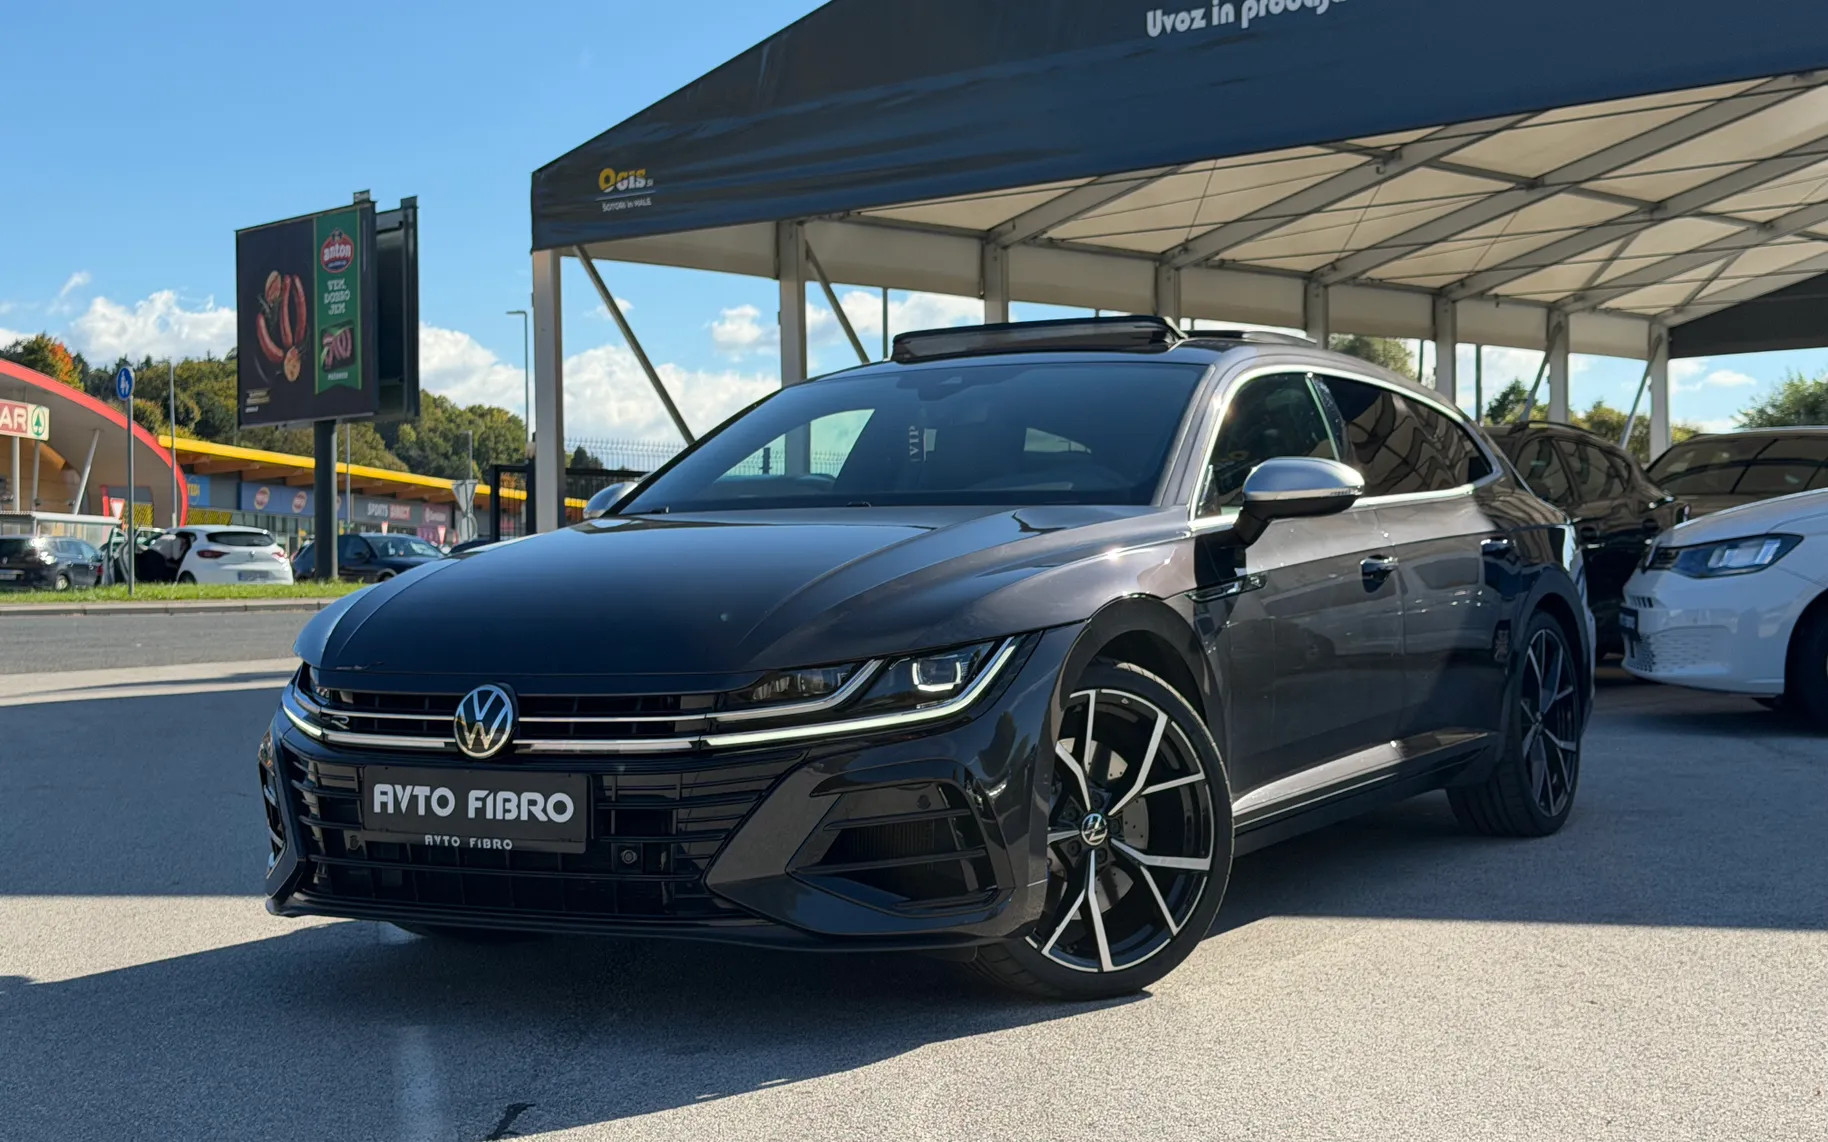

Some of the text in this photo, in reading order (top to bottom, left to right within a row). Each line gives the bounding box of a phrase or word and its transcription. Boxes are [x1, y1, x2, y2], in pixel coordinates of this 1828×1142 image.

[1146, 8, 1206, 38] Uvoz
[1212, 0, 1235, 26] in
[373, 784, 574, 823] AVTO FIBRO
[425, 834, 513, 850] AVTO FIBRO
